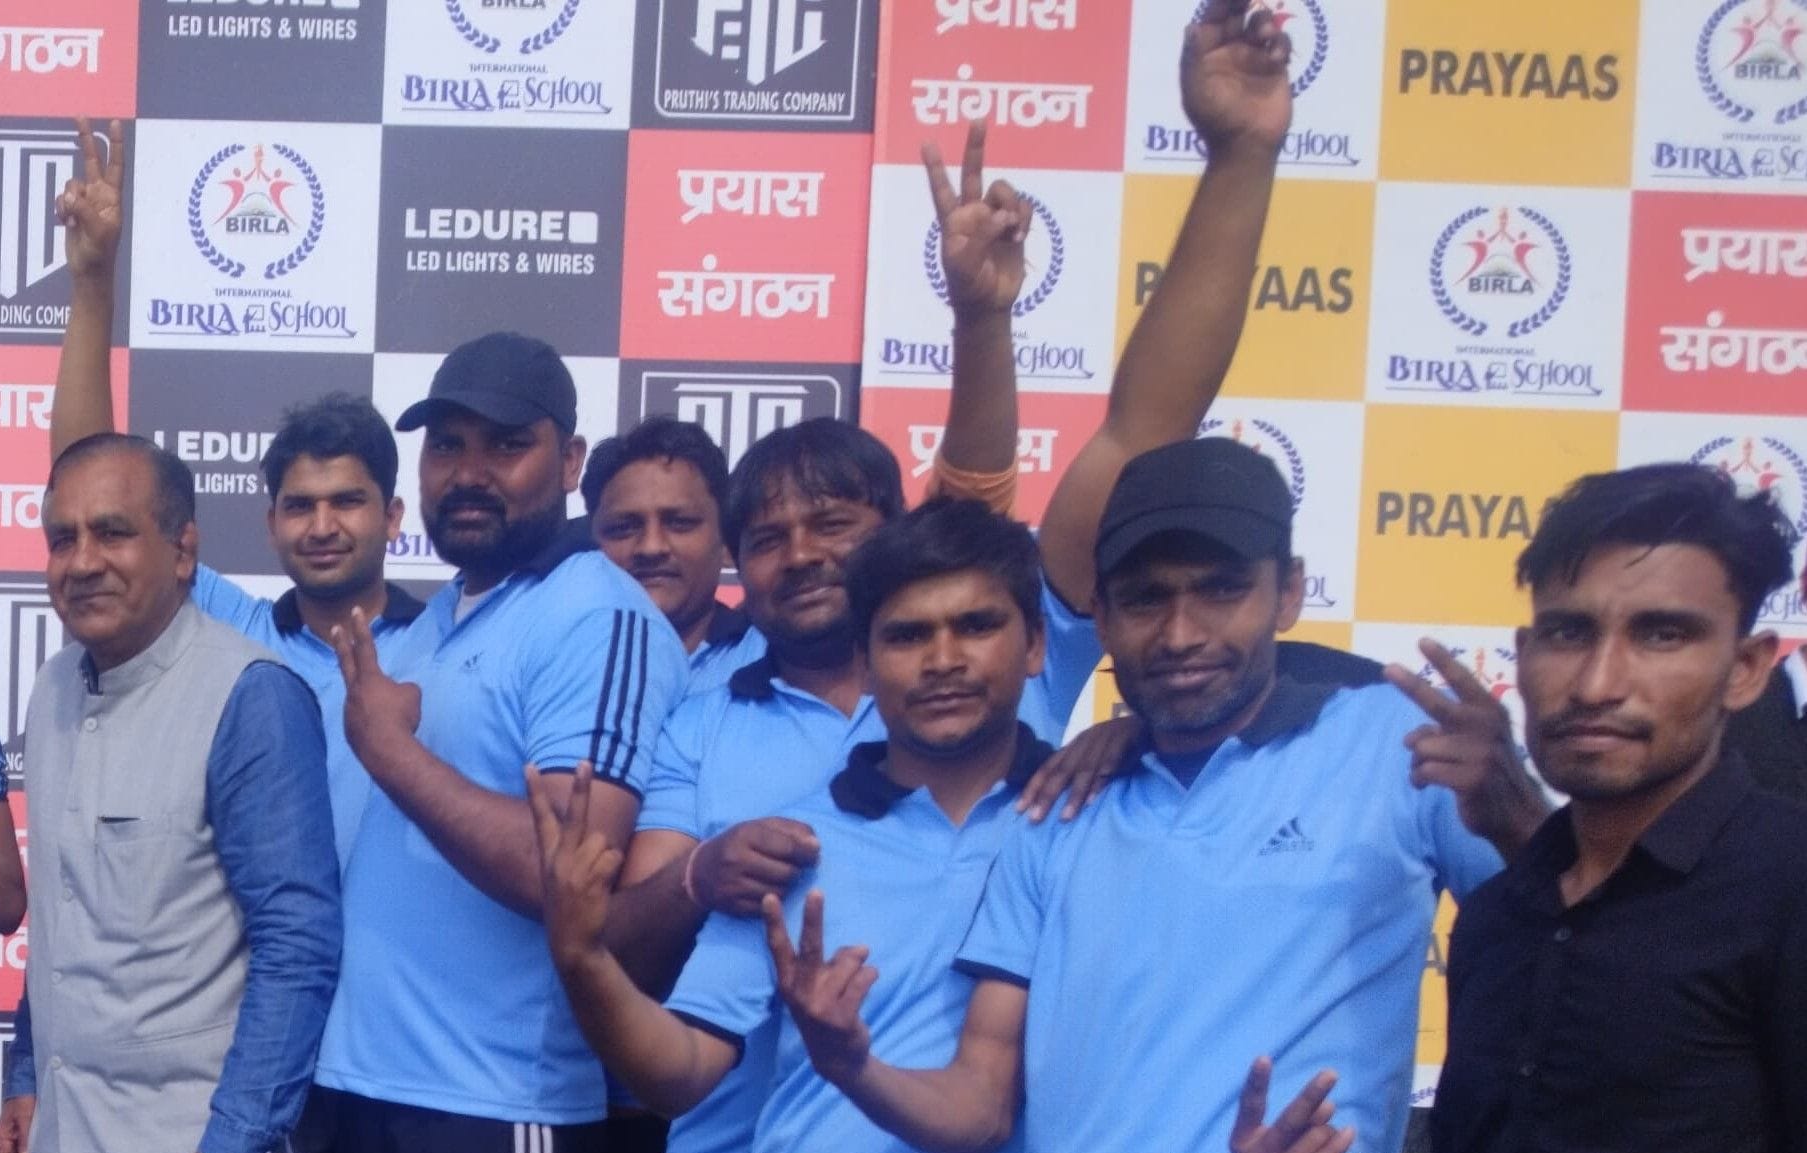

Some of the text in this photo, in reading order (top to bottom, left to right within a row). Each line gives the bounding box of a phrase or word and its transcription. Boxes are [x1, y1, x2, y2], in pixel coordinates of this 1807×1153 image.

[168, 16, 357, 40] LED LIGHTS & WIRES
[469, 63, 548, 74] INTERNATIONAL
[1399, 48, 1620, 101] PRAYAAS
[1734, 63, 1802, 80] BIRLA
[401, 75, 613, 114] BIRLA SCHOOL
[663, 89, 845, 113] PRUTHI'S TRADING COMPANY
[911, 64, 1092, 128] संगठन
[1651, 143, 1746, 179] BIRLA
[677, 169, 824, 223] प्रयास
[225, 217, 290, 234] BIRLA
[405, 208, 565, 242] LEDURE
[406, 251, 596, 275] LED LIGHTS & WIRES
[215, 288, 292, 298] INTERNATIONAL
[657, 254, 835, 318] संगठन
[1468, 277, 1534, 295] BIRLA
[148, 299, 357, 338] BIRLA SCHOOL
[1386, 356, 1602, 396] BIRLA SCHOOL
[194, 473, 258, 495] LIGHTS
